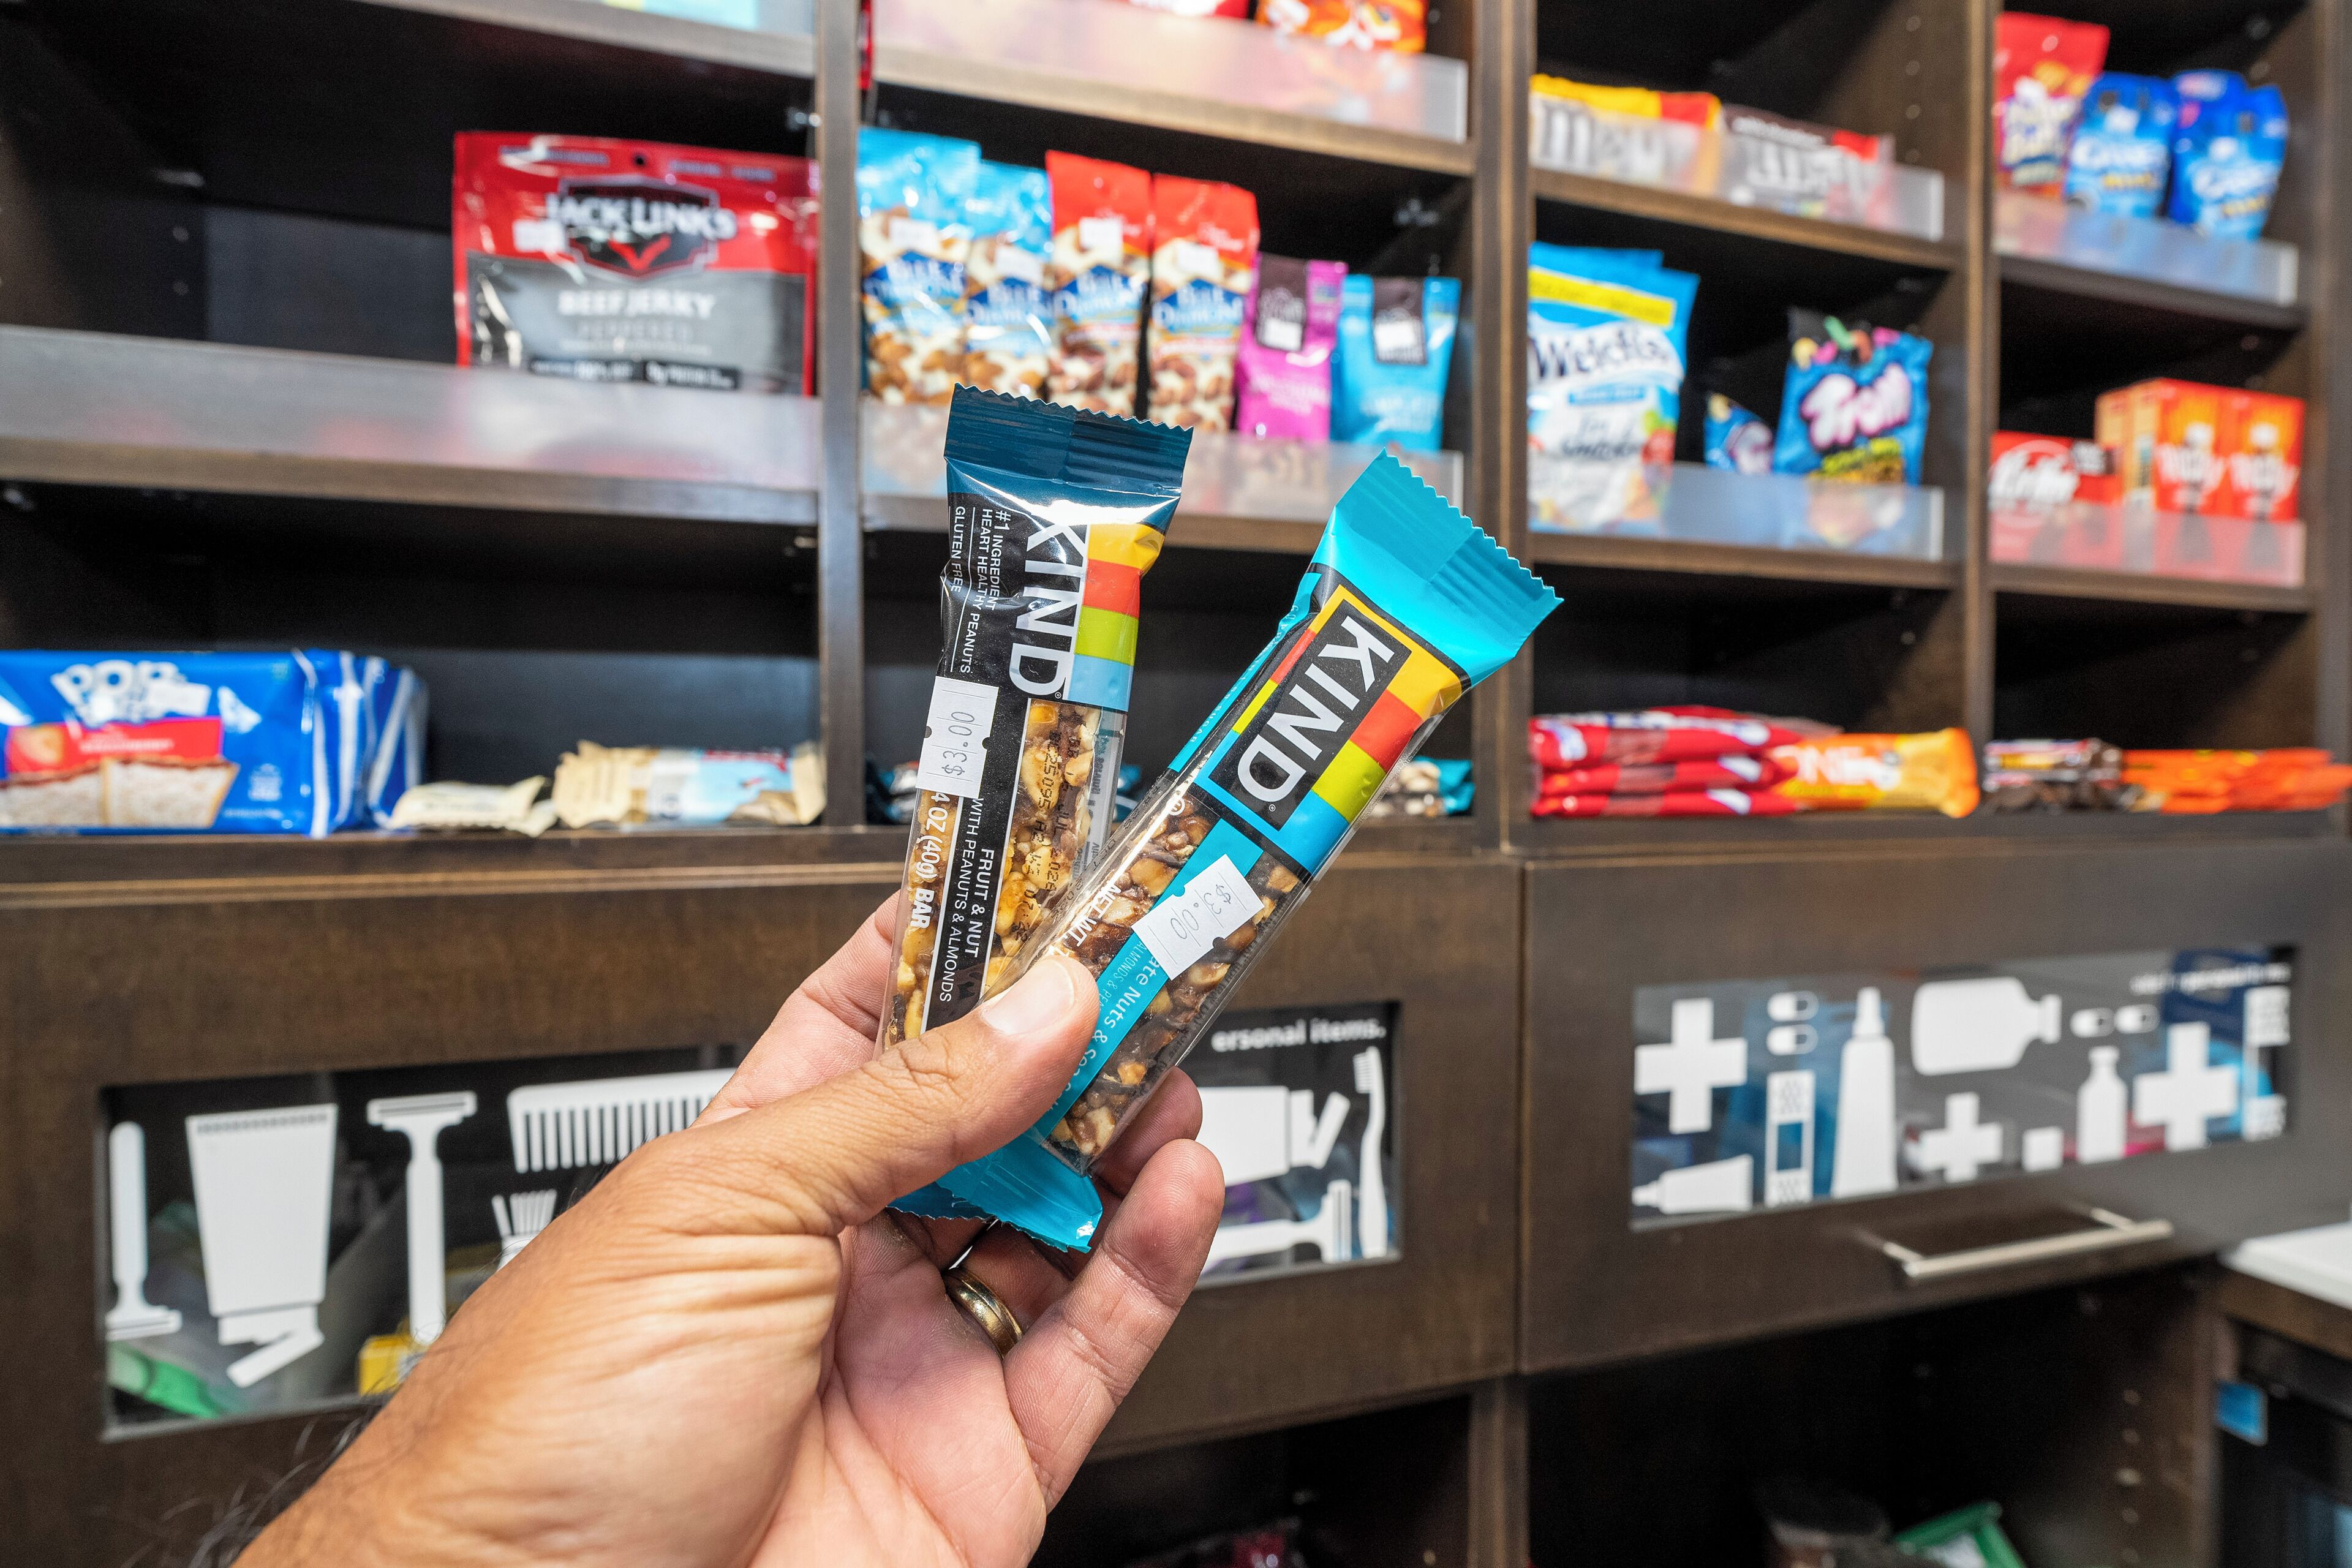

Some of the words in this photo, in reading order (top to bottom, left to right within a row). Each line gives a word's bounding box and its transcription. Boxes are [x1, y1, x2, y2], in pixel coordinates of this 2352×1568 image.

[557, 291, 624, 316] BEEF
[622, 292, 716, 318] JERKY
[951, 507, 965, 559] GLUTEN
[979, 509, 992, 552] HEART
[995, 510, 1011, 530] #1
[951, 564, 962, 592] FREE
[973, 557, 988, 609] HEALTHY
[985, 535, 1003, 610] INGREDIENT
[1008, 523, 1088, 696] KIND
[960, 613, 979, 673] PEANUTS
[1237, 615, 1395, 802] KIND
[941, 711, 975, 776] $3.00
[927, 805, 948, 833] OZ
[967, 798, 984, 836] WITH
[915, 834, 943, 880] (40g)
[954, 839, 977, 910] PEANUTS
[979, 849, 995, 901] FRUIT
[910, 888, 935, 929] BAR
[952, 912, 965, 922] &
[971, 905, 986, 915] &
[1085, 879, 1122, 920] NET
[1170, 883, 1232, 940] $3.00
[964, 919, 983, 958] NUT
[940, 925, 962, 1003] ALMONDS
[1114, 941, 1147, 984] ALMONDS
[1103, 986, 1142, 1029] Nuts
[1091, 1028, 1109, 1045] &
[1211, 1019, 1307, 1053] ersonal
